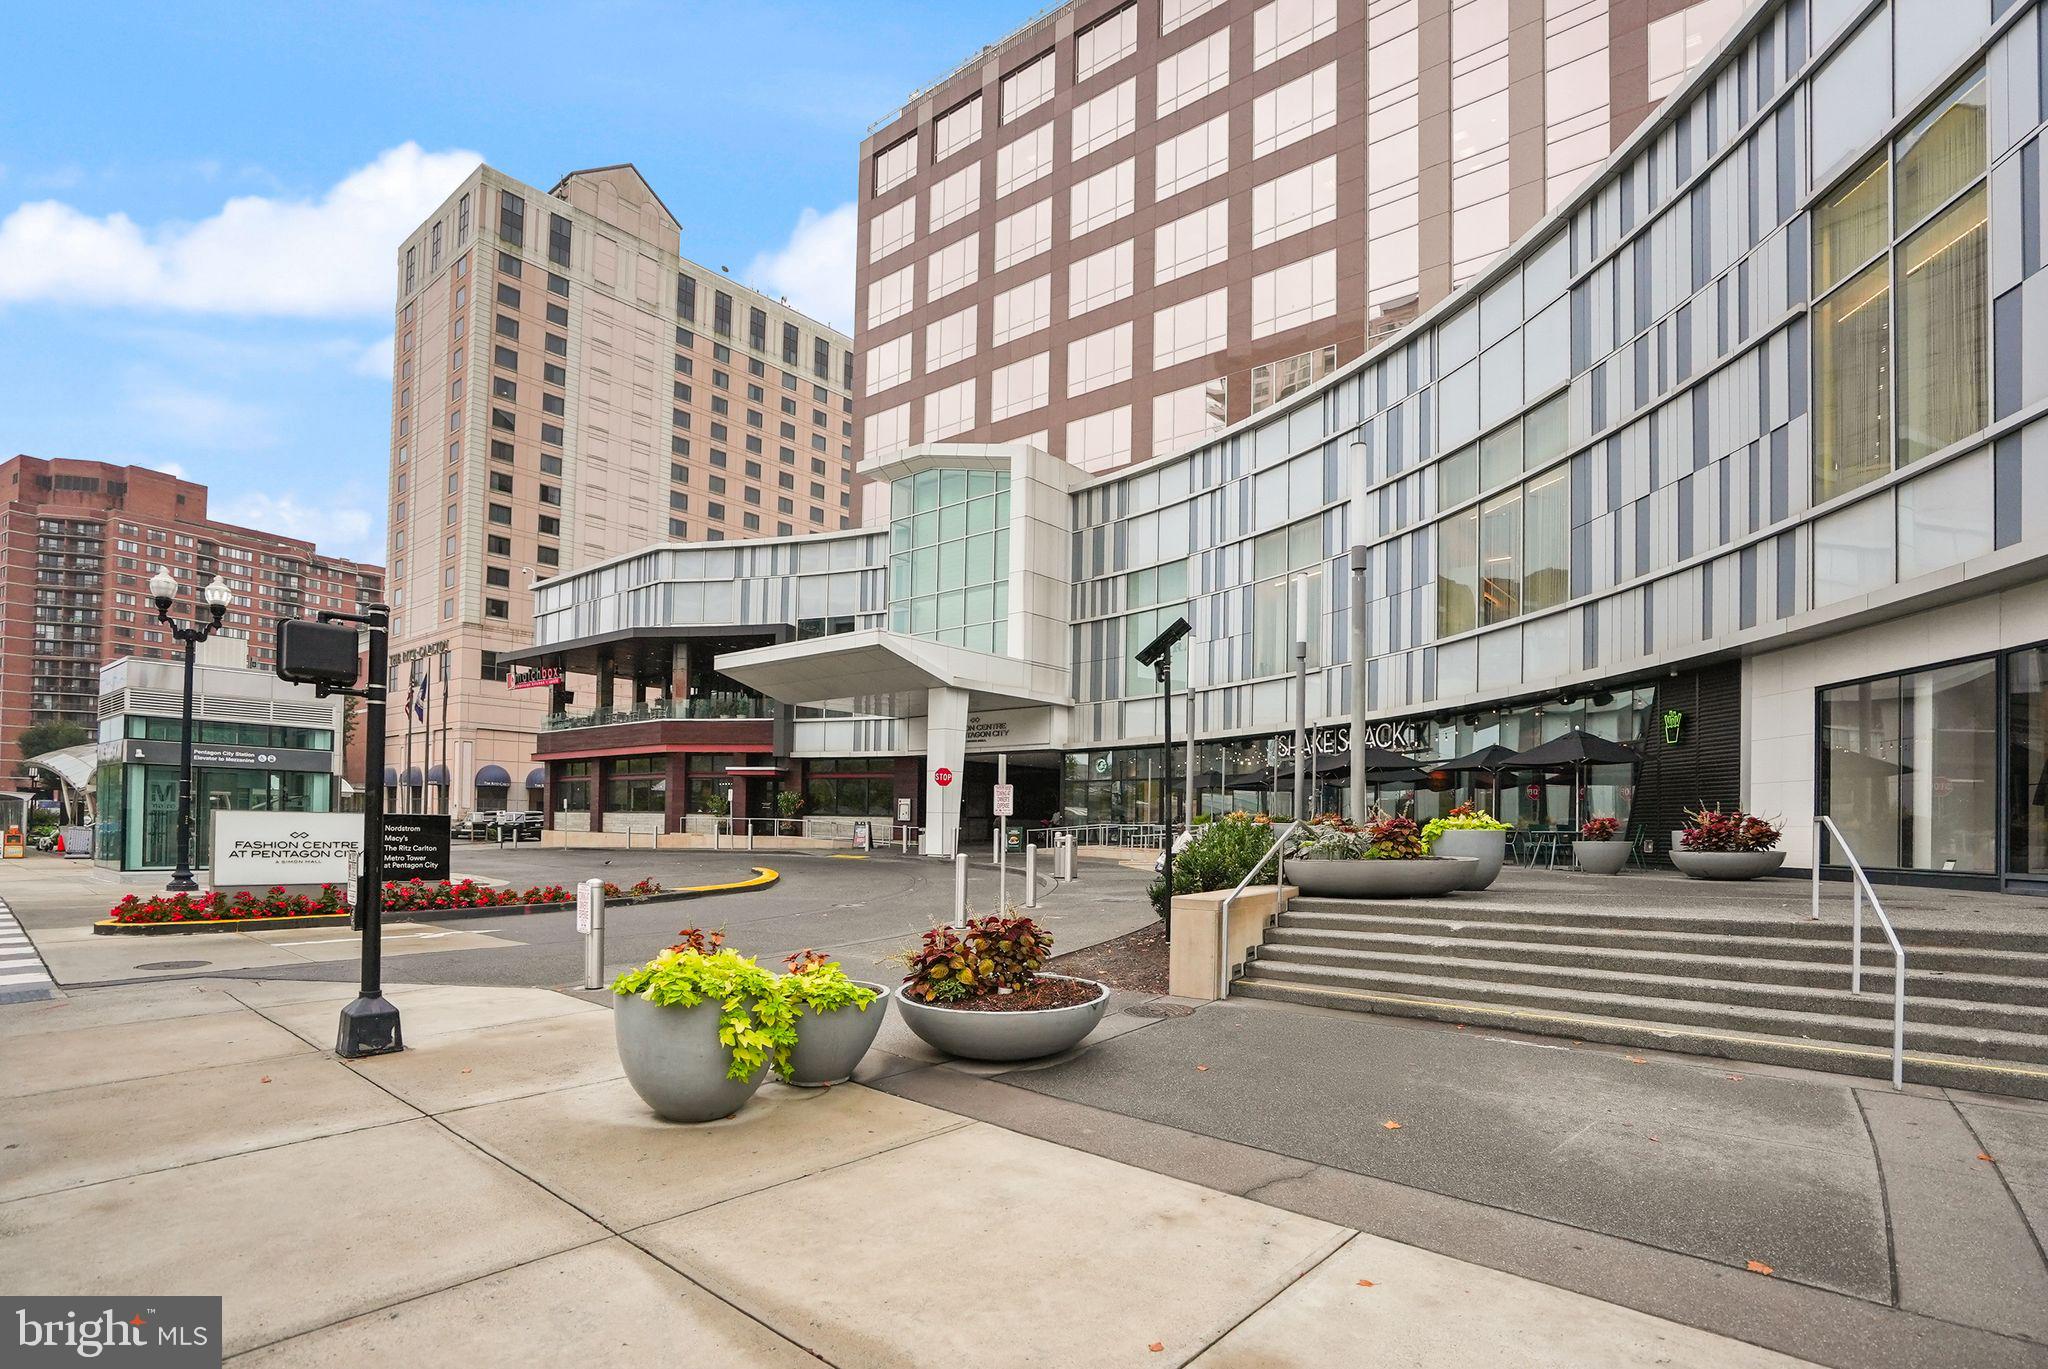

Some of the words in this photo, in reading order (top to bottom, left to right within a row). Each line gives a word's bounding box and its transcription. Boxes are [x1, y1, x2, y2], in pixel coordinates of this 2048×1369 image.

[976, 722, 1007, 731] CENTRE
[992, 729, 1010, 737] CITY
[1337, 720, 1406, 752] SACK
[193, 749, 222, 757] Pentagon
[222, 750, 235, 758] City
[235, 751, 256, 759] Station
[193, 754, 218, 762] Elevator
[935, 773, 953, 781] STOP
[384, 824, 421, 832] Nordstrom
[384, 834, 409, 843] Macy's
[235, 841, 299, 849] FASHION
[302, 841, 359, 849] CENTRE
[412, 844, 438, 852] Carlton
[229, 850, 248, 858] AT
[251, 850, 331, 858] PENTAGON
[392, 861, 424, 870] Pentagon
[424, 861, 439, 869] City
